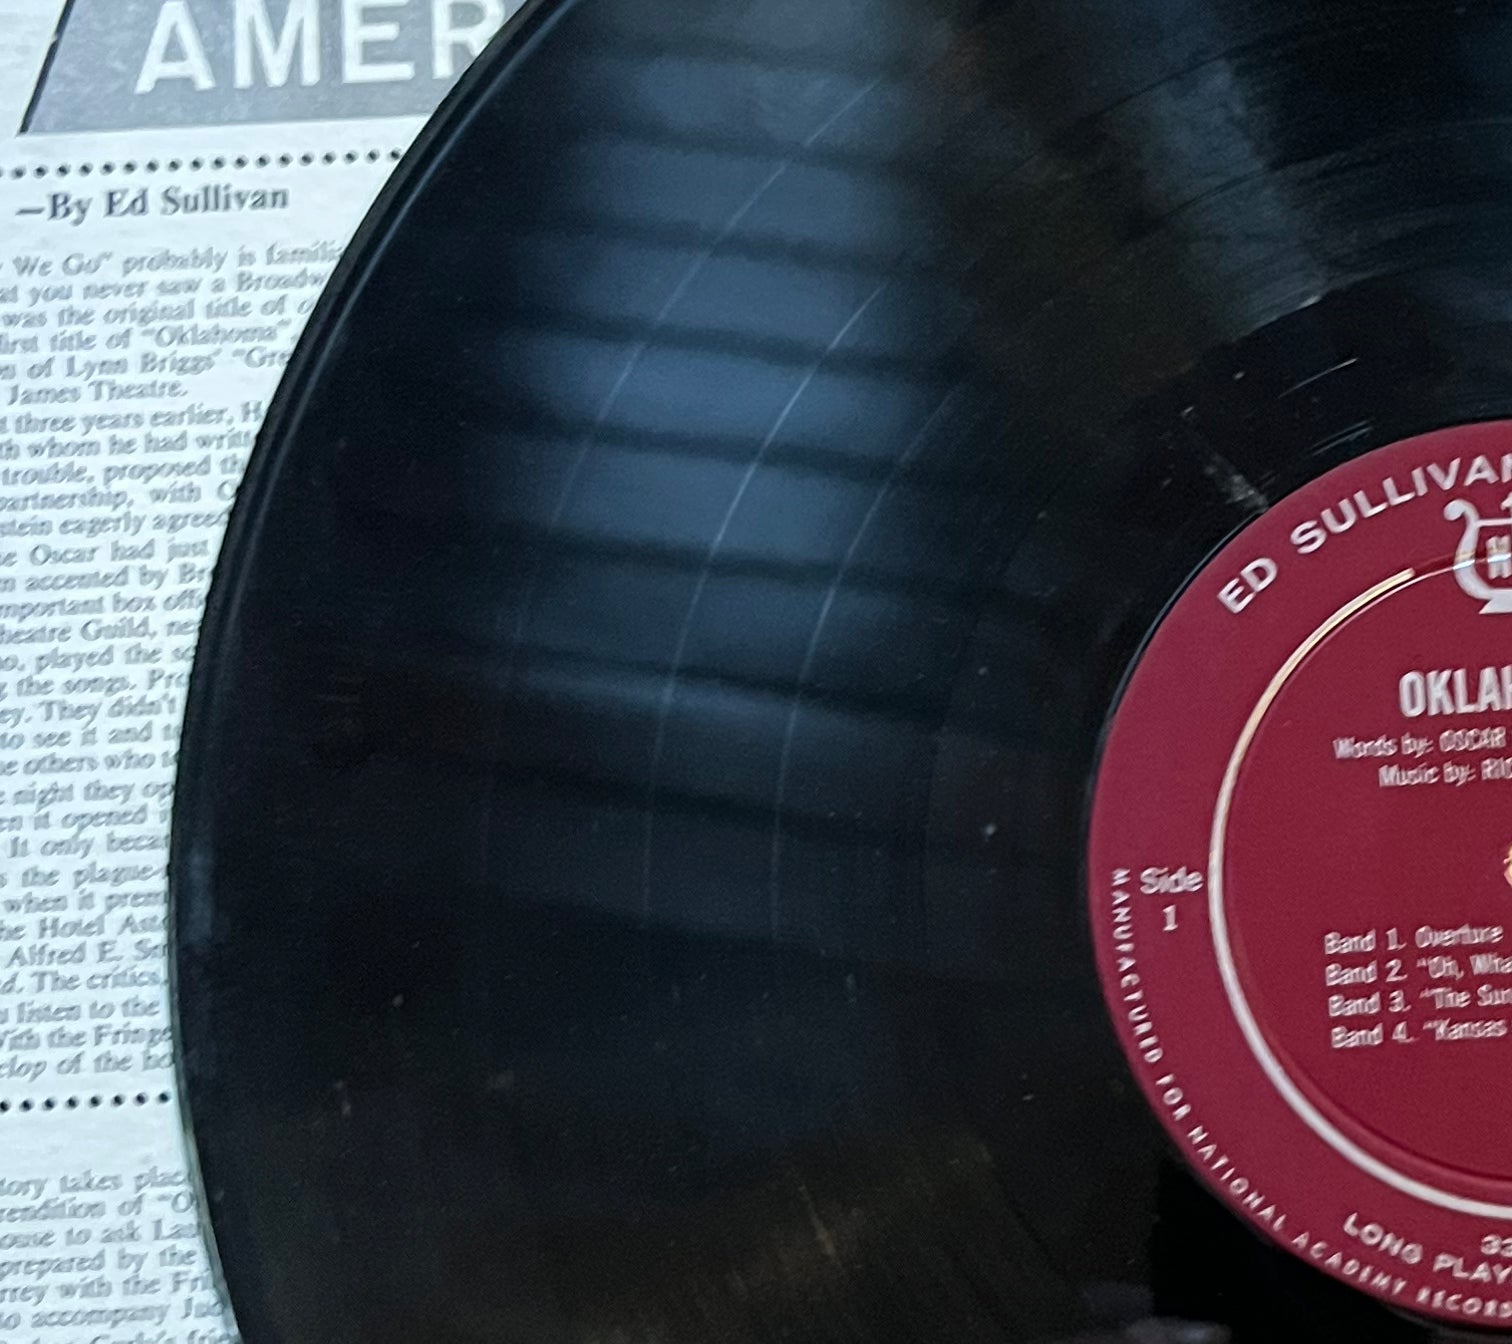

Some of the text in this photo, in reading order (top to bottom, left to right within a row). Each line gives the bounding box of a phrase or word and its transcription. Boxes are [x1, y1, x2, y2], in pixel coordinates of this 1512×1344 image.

[104, 189, 150, 217] Ed
[160, 183, 290, 216] Sullivan
[122, 246, 228, 278] probably
[238, 244, 257, 267] is
[29, 277, 227, 307] you never saw a
[1, 294, 288, 328] was the original title of
[50, 329, 97, 352] title
[106, 328, 133, 350] of
[27, 356, 55, 380] of
[66, 355, 128, 381] Lynn
[7, 384, 81, 405] James
[15, 411, 76, 434] three
[80, 412, 145, 436] years
[30, 543, 100, 565] Oscar
[111, 538, 155, 562] had
[1217, 558, 1278, 613] ED
[1333, 733, 1397, 759] Words
[1439, 726, 1506, 752] OSCAR
[1379, 763, 1438, 788] Music
[1140, 866, 1204, 895] Side
[1163, 904, 1179, 932] 1
[1324, 924, 1503, 955] Band 1. Overture
[30, 970, 81, 993] The
[1326, 959, 1378, 986] Band
[1385, 958, 1408, 982] 2.
[89, 1001, 116, 1019] to
[122, 994, 160, 1017] the
[1328, 991, 1381, 1018] Band
[1388, 989, 1412, 1012] 3.
[1331, 1022, 1384, 1049] Band
[1392, 1021, 1418, 1043] 4.
[1111, 867, 1163, 1063] MANUFACTURED
[1155, 1073, 1192, 1121] FOR
[1186, 1125, 1287, 1232] NATIONAL
[1291, 1231, 1407, 1296] ACADEMY
[1343, 1212, 1423, 1265] LONG
